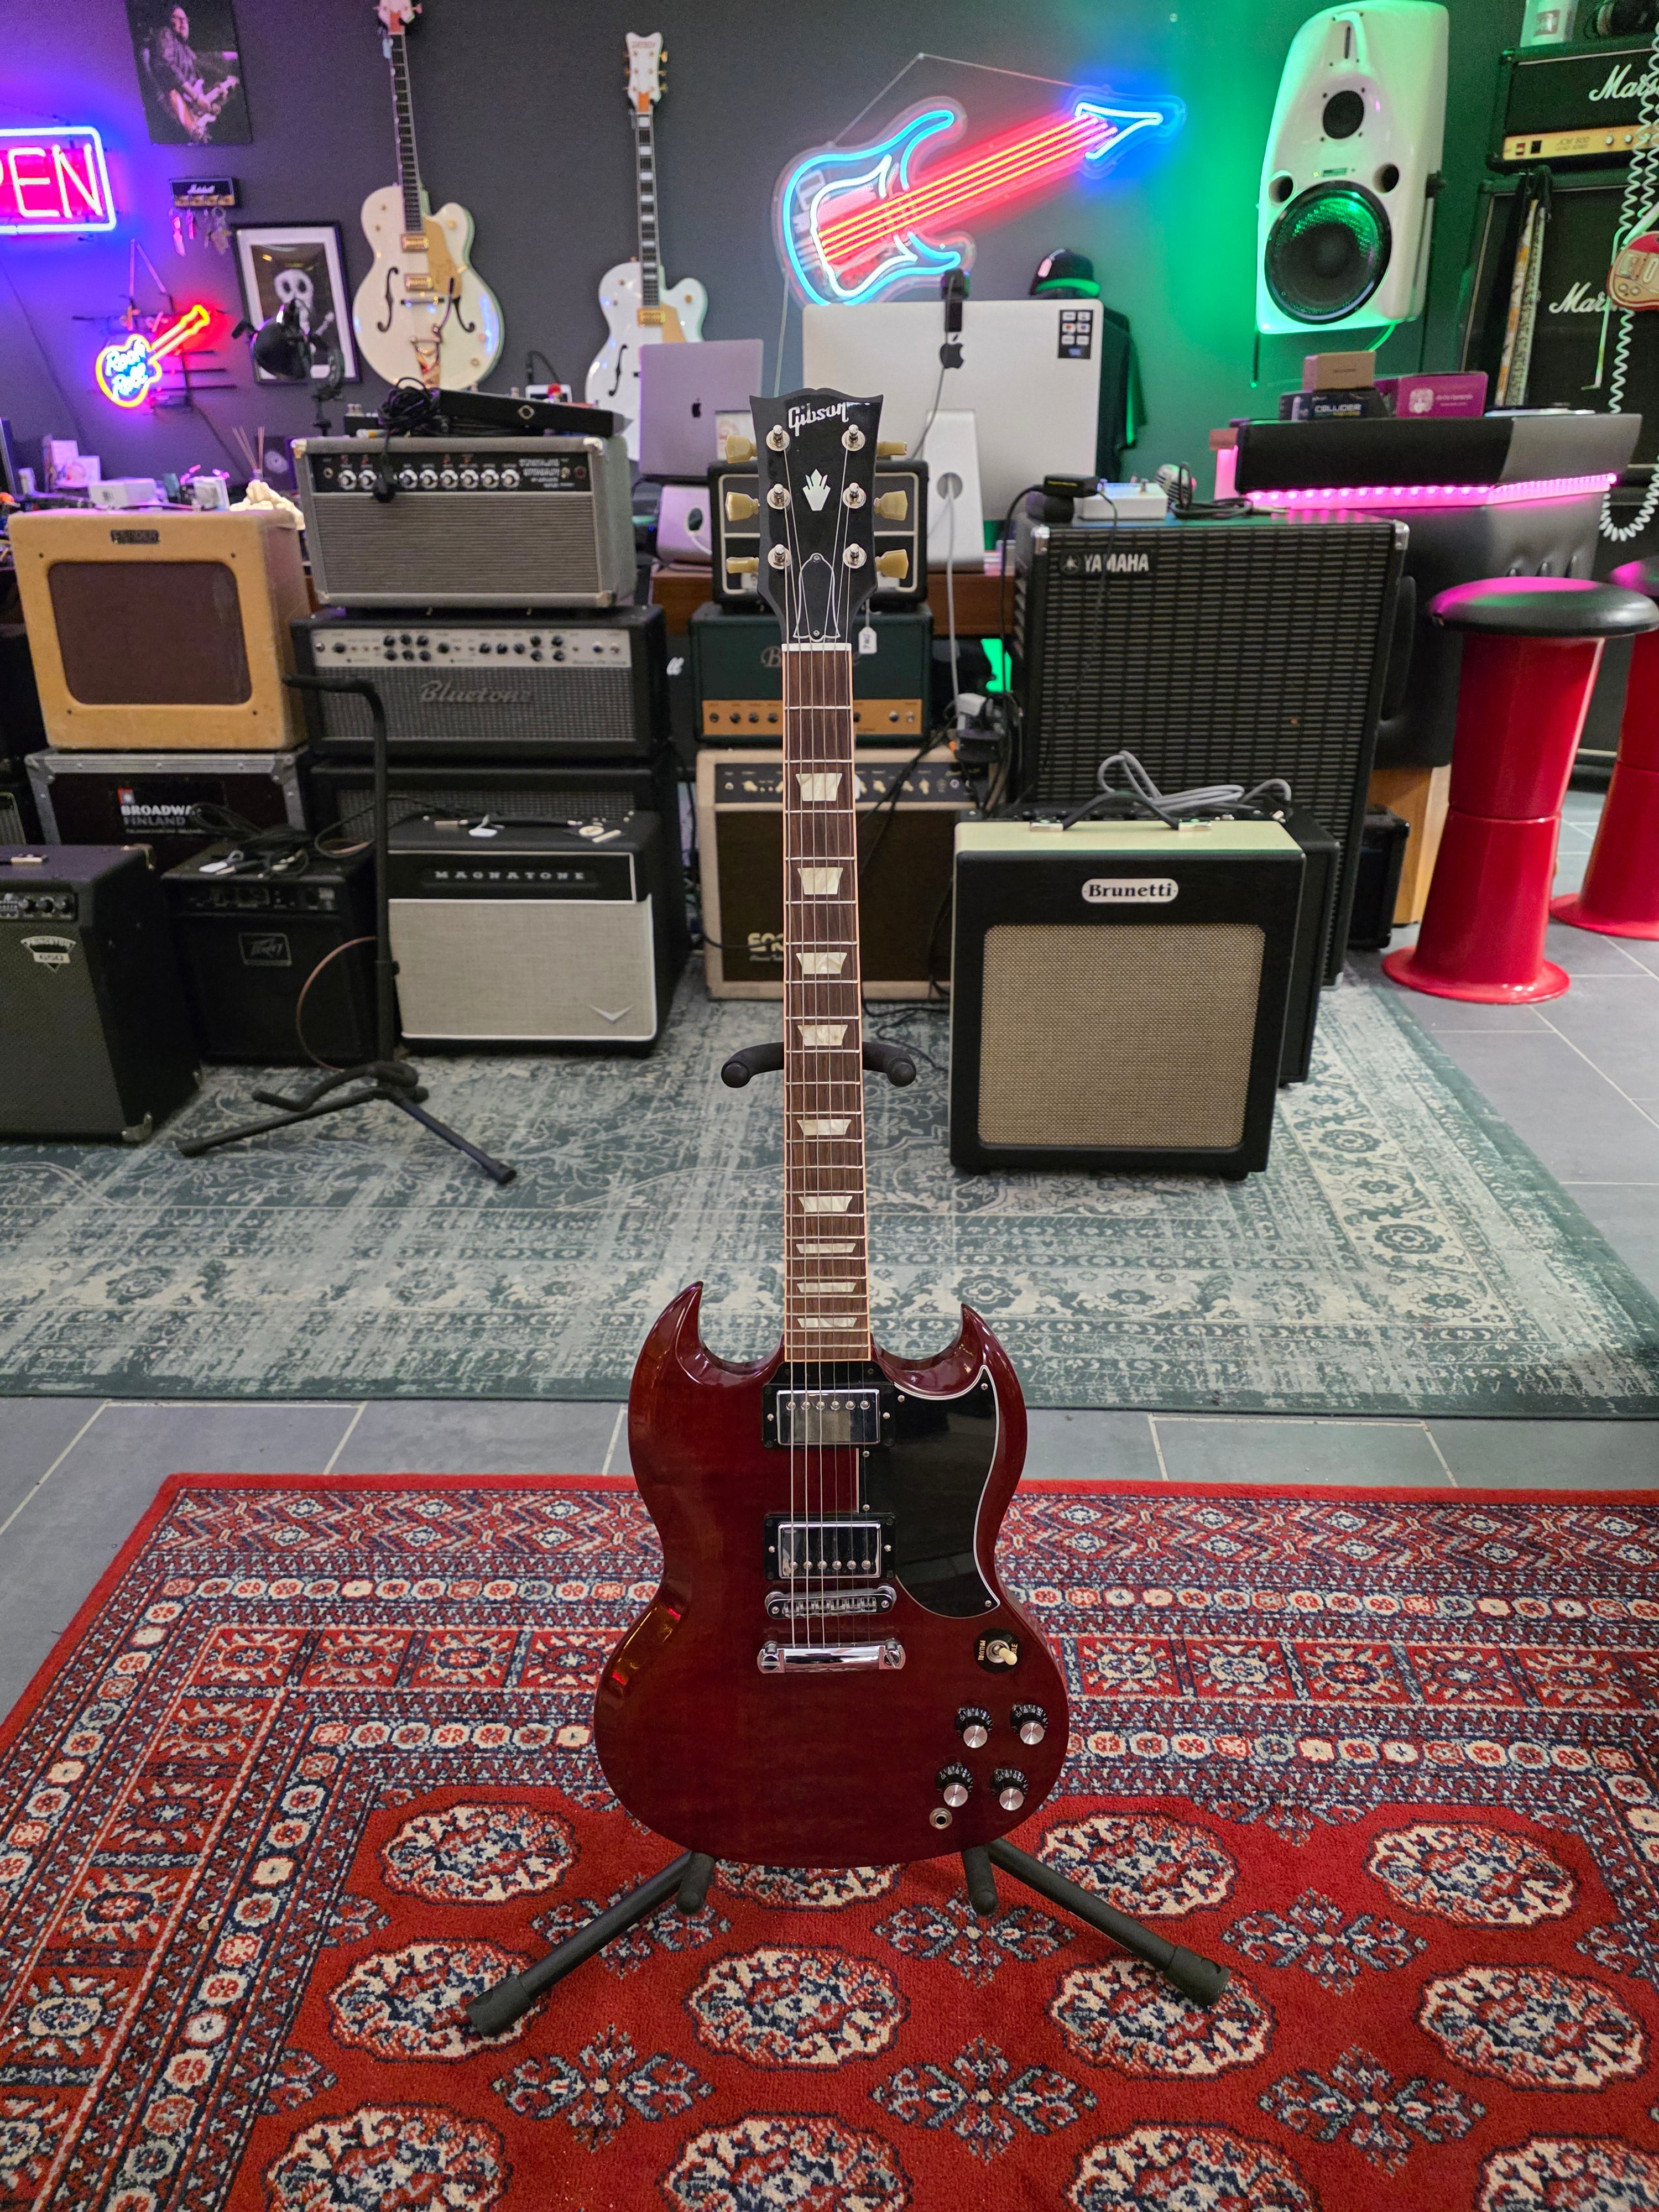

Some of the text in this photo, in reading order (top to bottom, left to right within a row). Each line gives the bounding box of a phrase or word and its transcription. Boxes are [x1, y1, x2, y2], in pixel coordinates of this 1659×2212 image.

[0, 144, 104, 218] EN
[788, 403, 849, 437] Gibson
[1084, 554, 1149, 572] YAMAHA
[420, 680, 533, 703] Bluetone
[121, 805, 202, 816] BROADWA
[123, 816, 186, 826] FINLAND
[435, 871, 585, 880] MAGNATONE
[1088, 883, 1172, 897] Brunetti
[978, 1640, 986, 1661] RHYTHM
